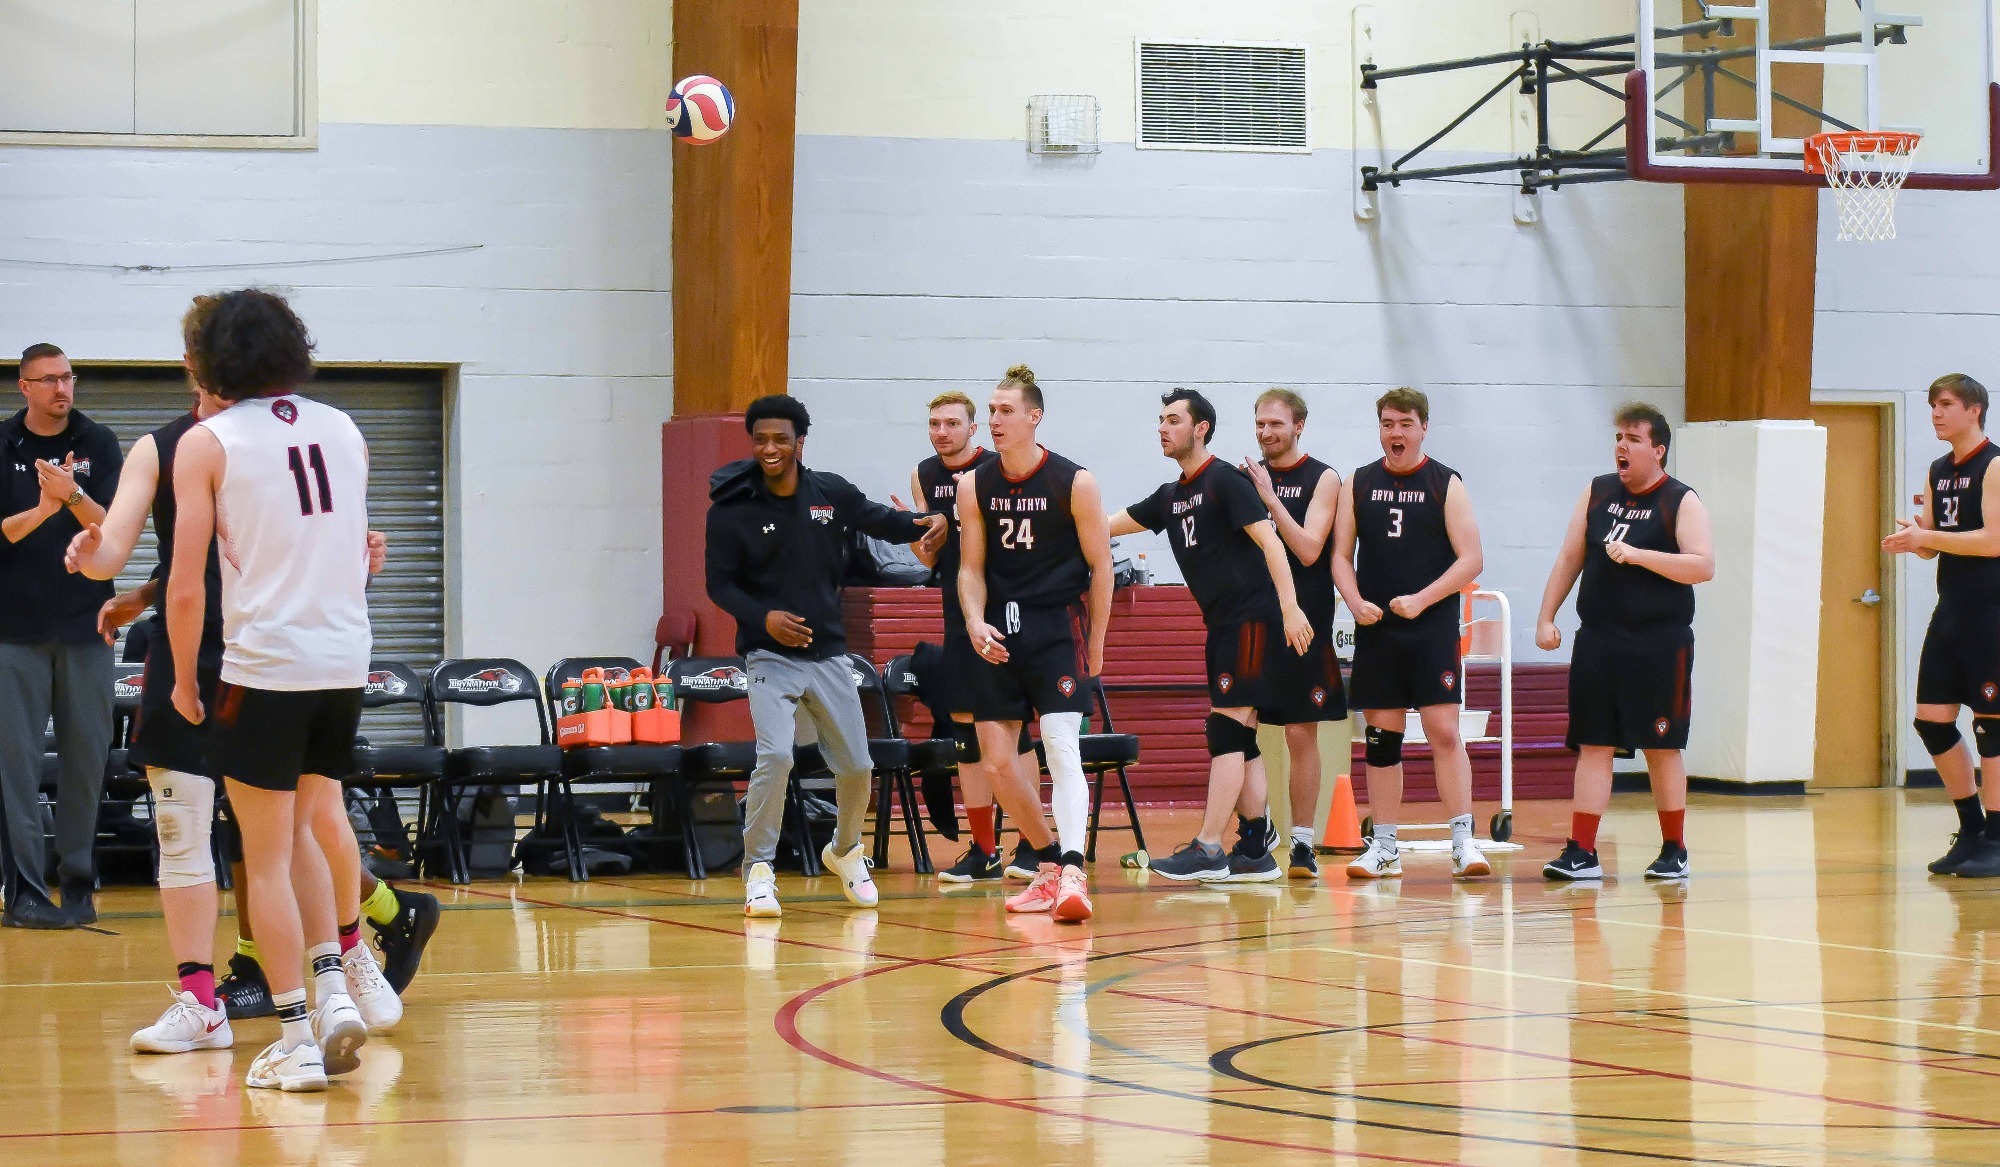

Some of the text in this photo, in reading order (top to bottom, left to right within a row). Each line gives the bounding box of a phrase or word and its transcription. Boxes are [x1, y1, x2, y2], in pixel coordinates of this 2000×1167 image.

[288, 443, 333, 516] 11
[934, 485, 954, 498] BRYN
[1016, 498, 1047, 511] ATHYN
[1371, 489, 1425, 503] BRYN ATHYN
[1387, 508, 1403, 538] 3
[1940, 496, 1959, 527] 32
[999, 518, 1034, 550] 24
[1182, 515, 1198, 548] 12
